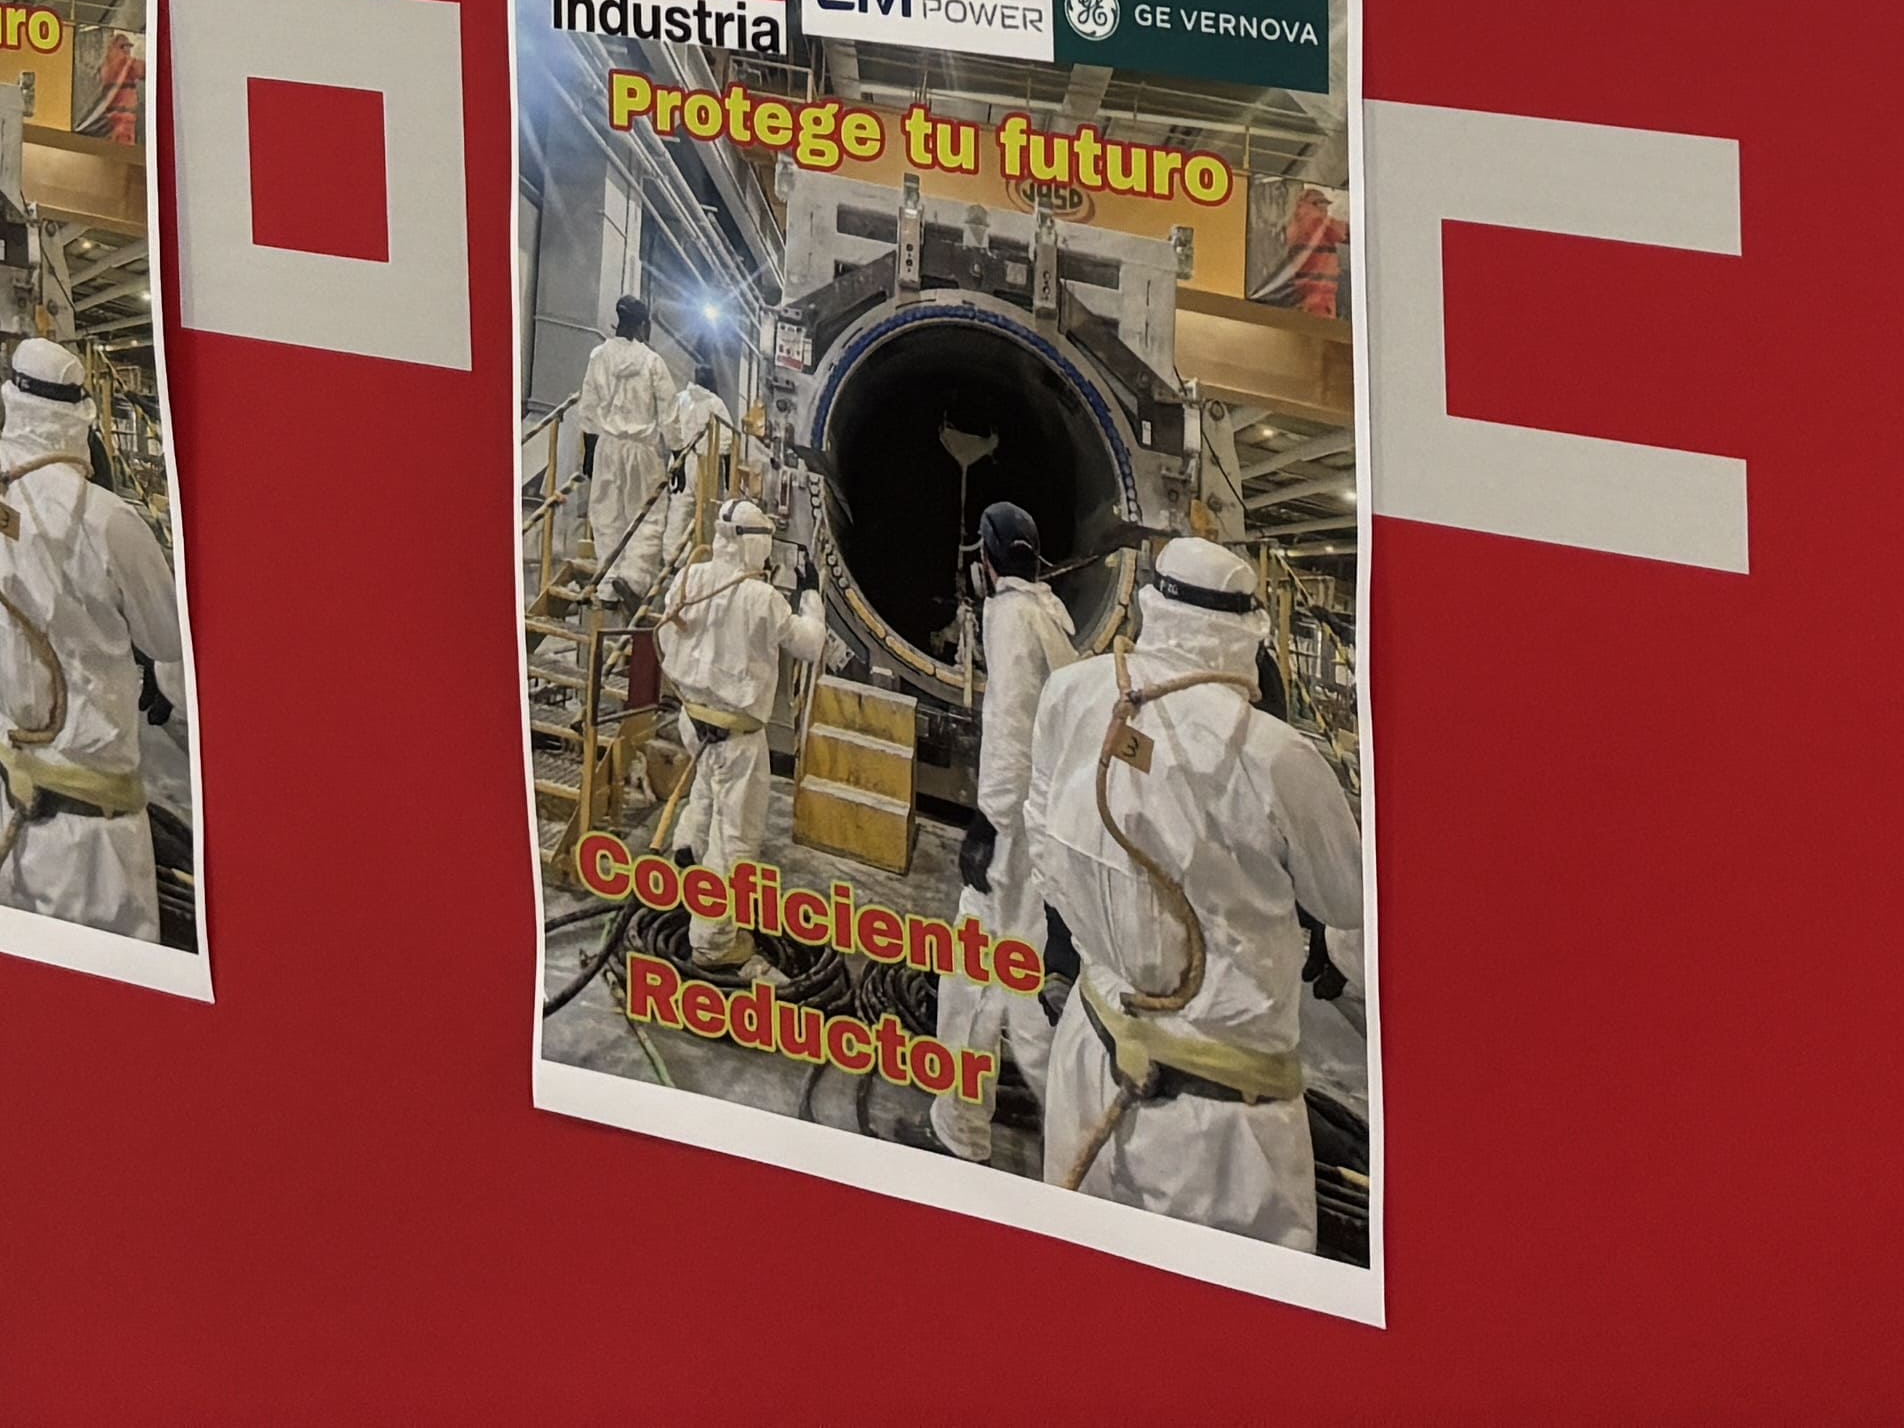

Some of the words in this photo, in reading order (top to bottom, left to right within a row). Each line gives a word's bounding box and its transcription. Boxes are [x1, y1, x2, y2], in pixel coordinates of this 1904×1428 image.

[1134, 3, 1173, 31] GE
[1179, 8, 1320, 48] VERNOVA
[608, 69, 885, 171] Protege
[905, 101, 980, 176] tu
[1001, 112, 1234, 209] futuro
[575, 829, 1047, 996] Coeficiente
[626, 953, 997, 1105] Reductor
